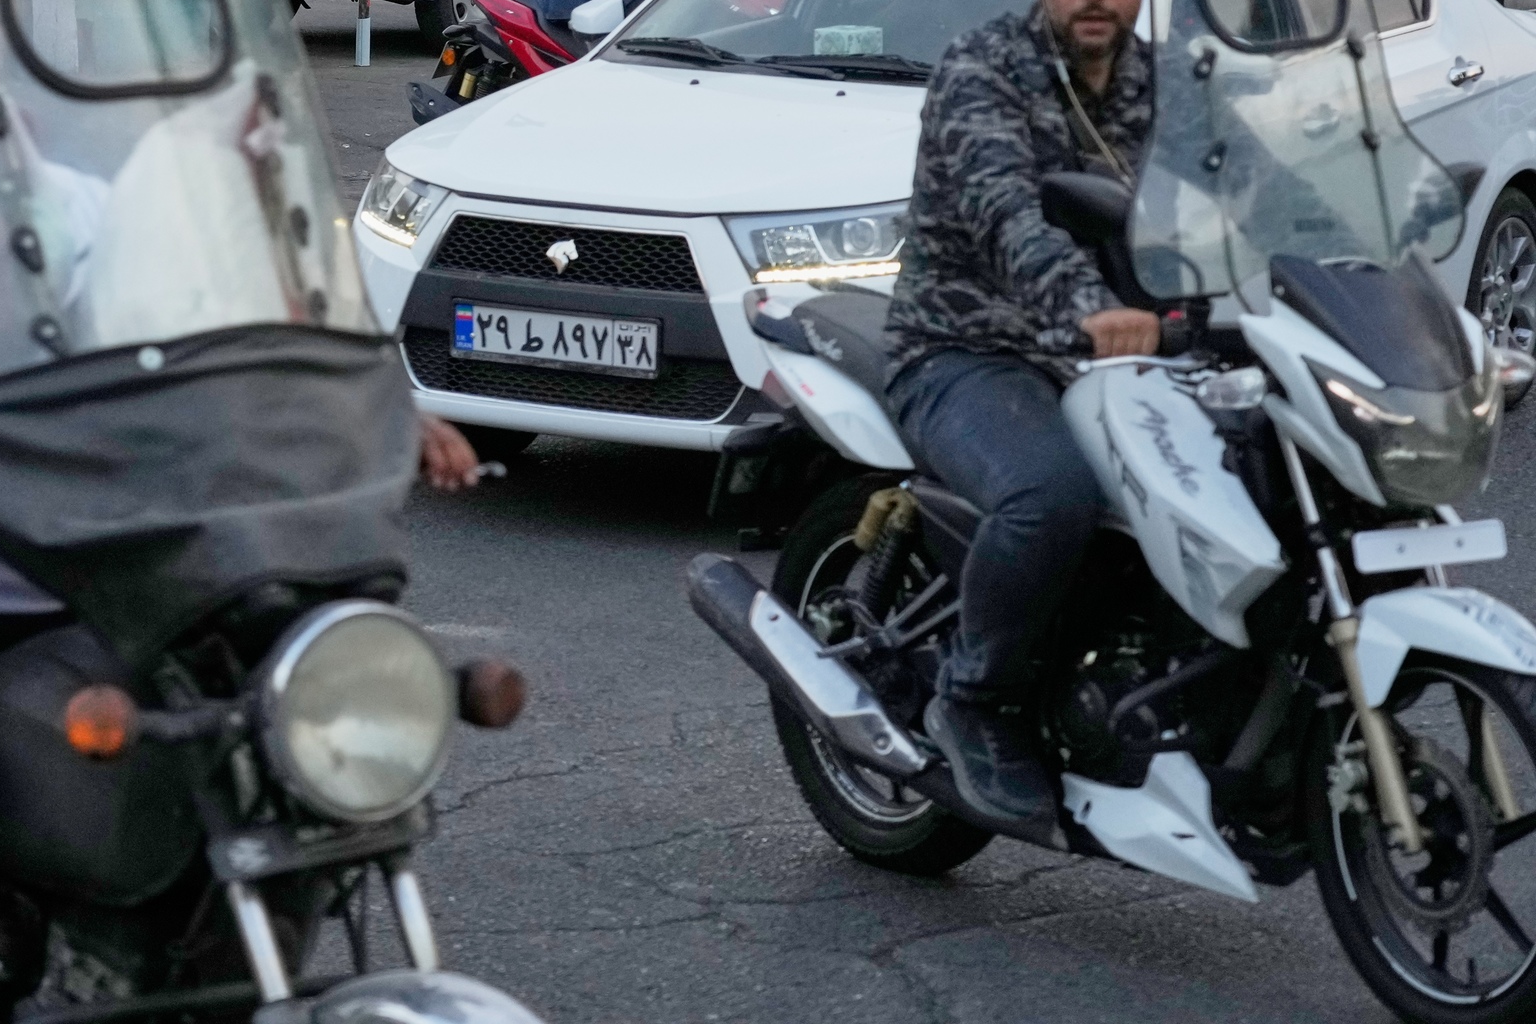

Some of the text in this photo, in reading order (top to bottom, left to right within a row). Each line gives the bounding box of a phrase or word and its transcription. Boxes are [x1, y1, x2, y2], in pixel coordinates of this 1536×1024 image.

[476, 313, 608, 361] ۲۹ ط ۸۹۷
[617, 333, 652, 367] ۳۸
